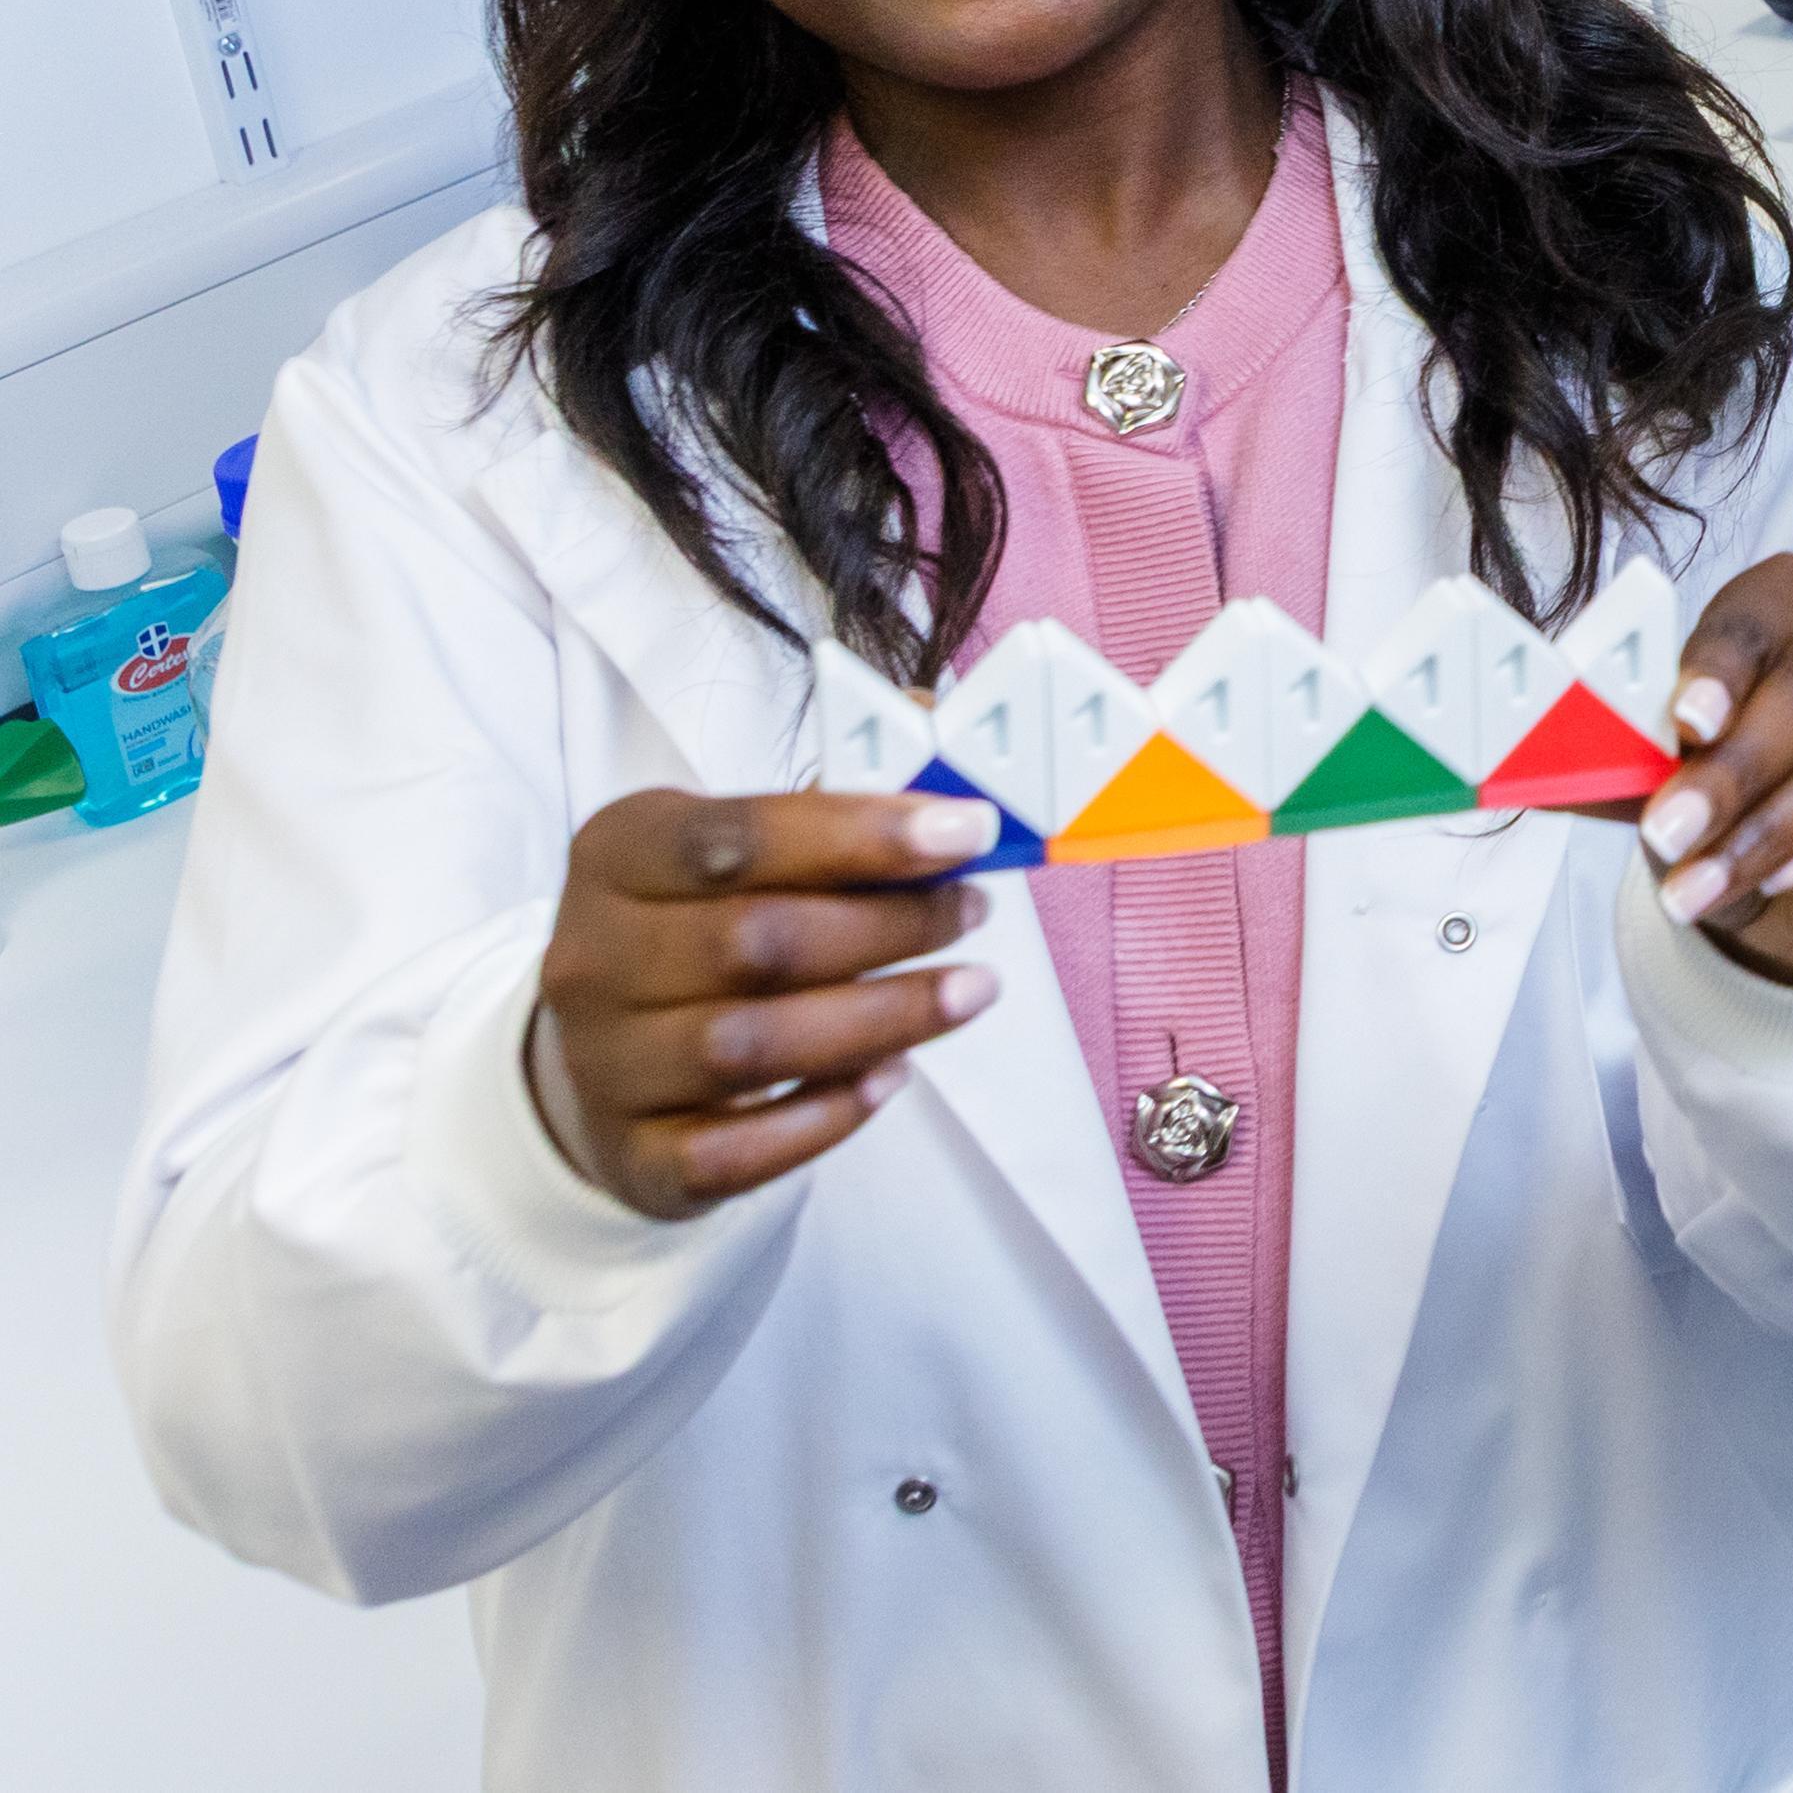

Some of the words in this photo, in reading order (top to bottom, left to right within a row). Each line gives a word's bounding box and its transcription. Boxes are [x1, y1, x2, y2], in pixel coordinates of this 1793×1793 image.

[129, 650, 189, 689] Certe
[847, 713, 880, 770] 1
[974, 701, 1009, 757] 1
[1073, 690, 1108, 747] 1
[1199, 676, 1230, 732] 1
[1289, 666, 1321, 720] 1
[1406, 653, 1439, 706] 1
[1496, 642, 1528, 696] 1
[1610, 628, 1642, 683] 1
